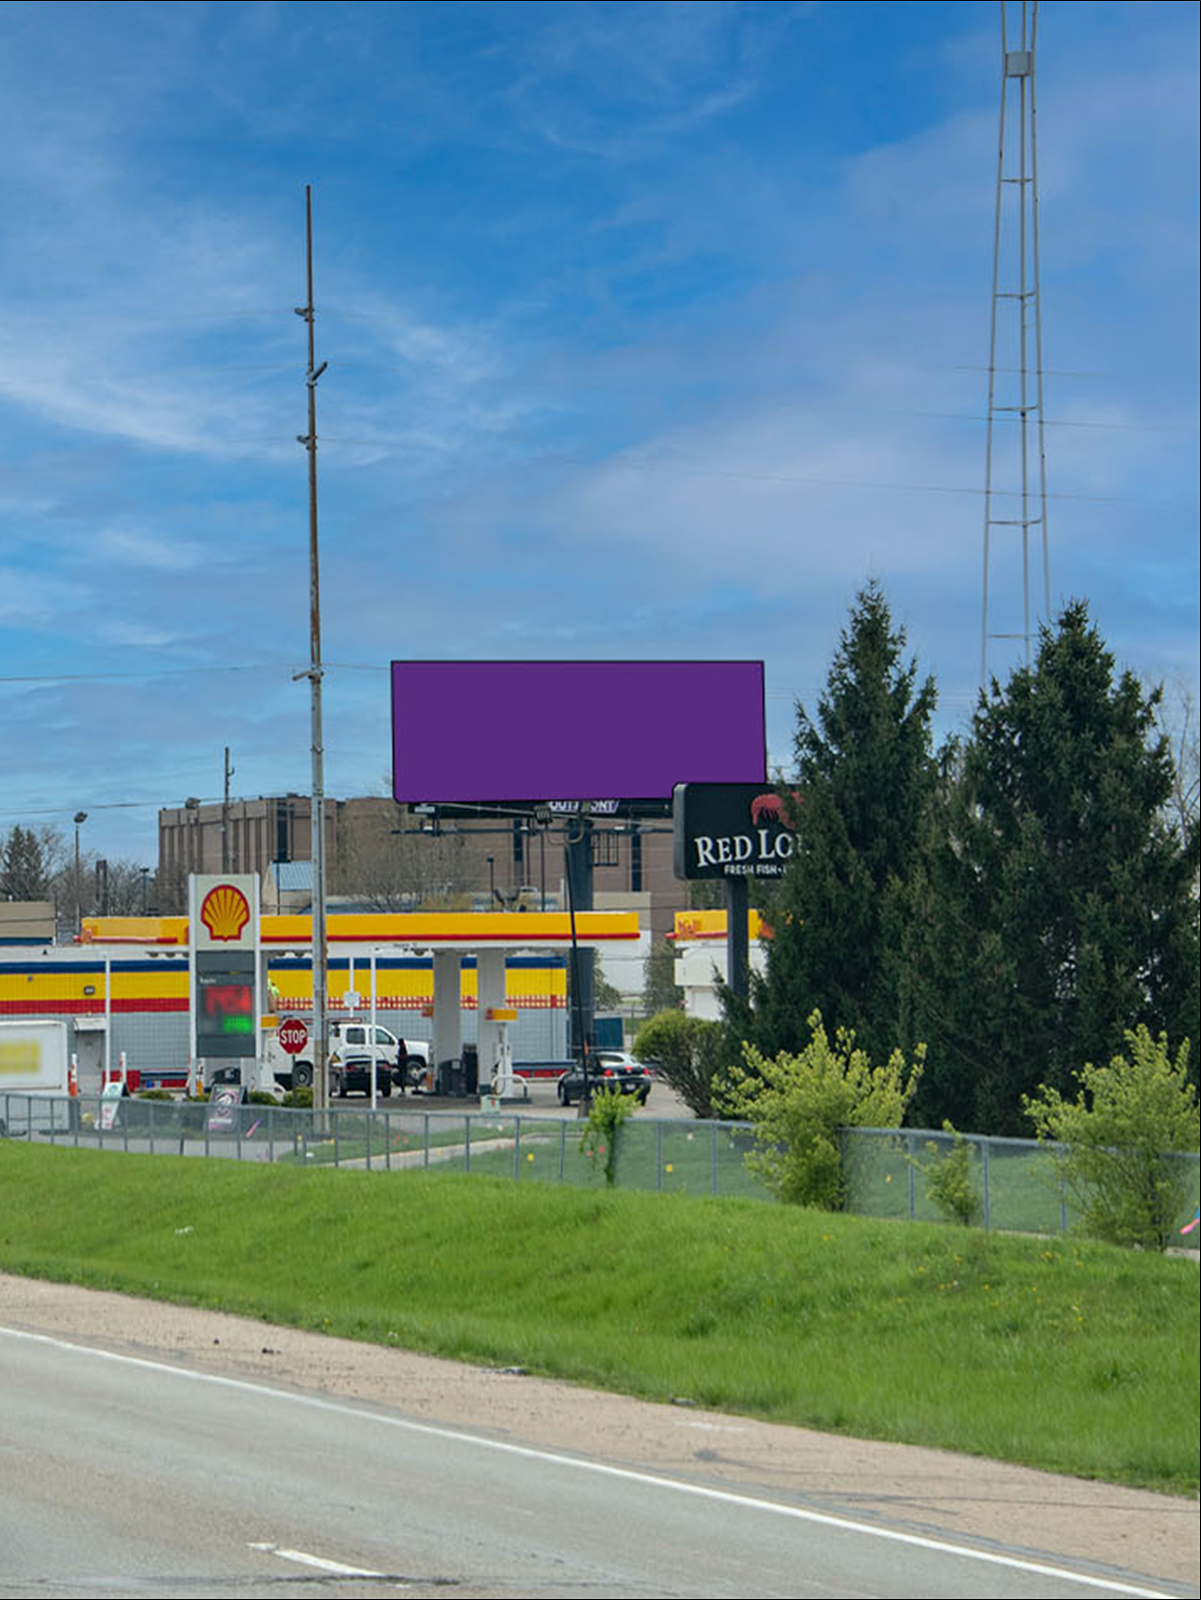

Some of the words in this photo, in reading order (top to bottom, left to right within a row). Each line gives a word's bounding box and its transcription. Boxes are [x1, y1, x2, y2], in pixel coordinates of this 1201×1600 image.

[694, 836, 753, 867] RED
[724, 864, 754, 875] FRESH
[280, 1029, 308, 1044] STOP
